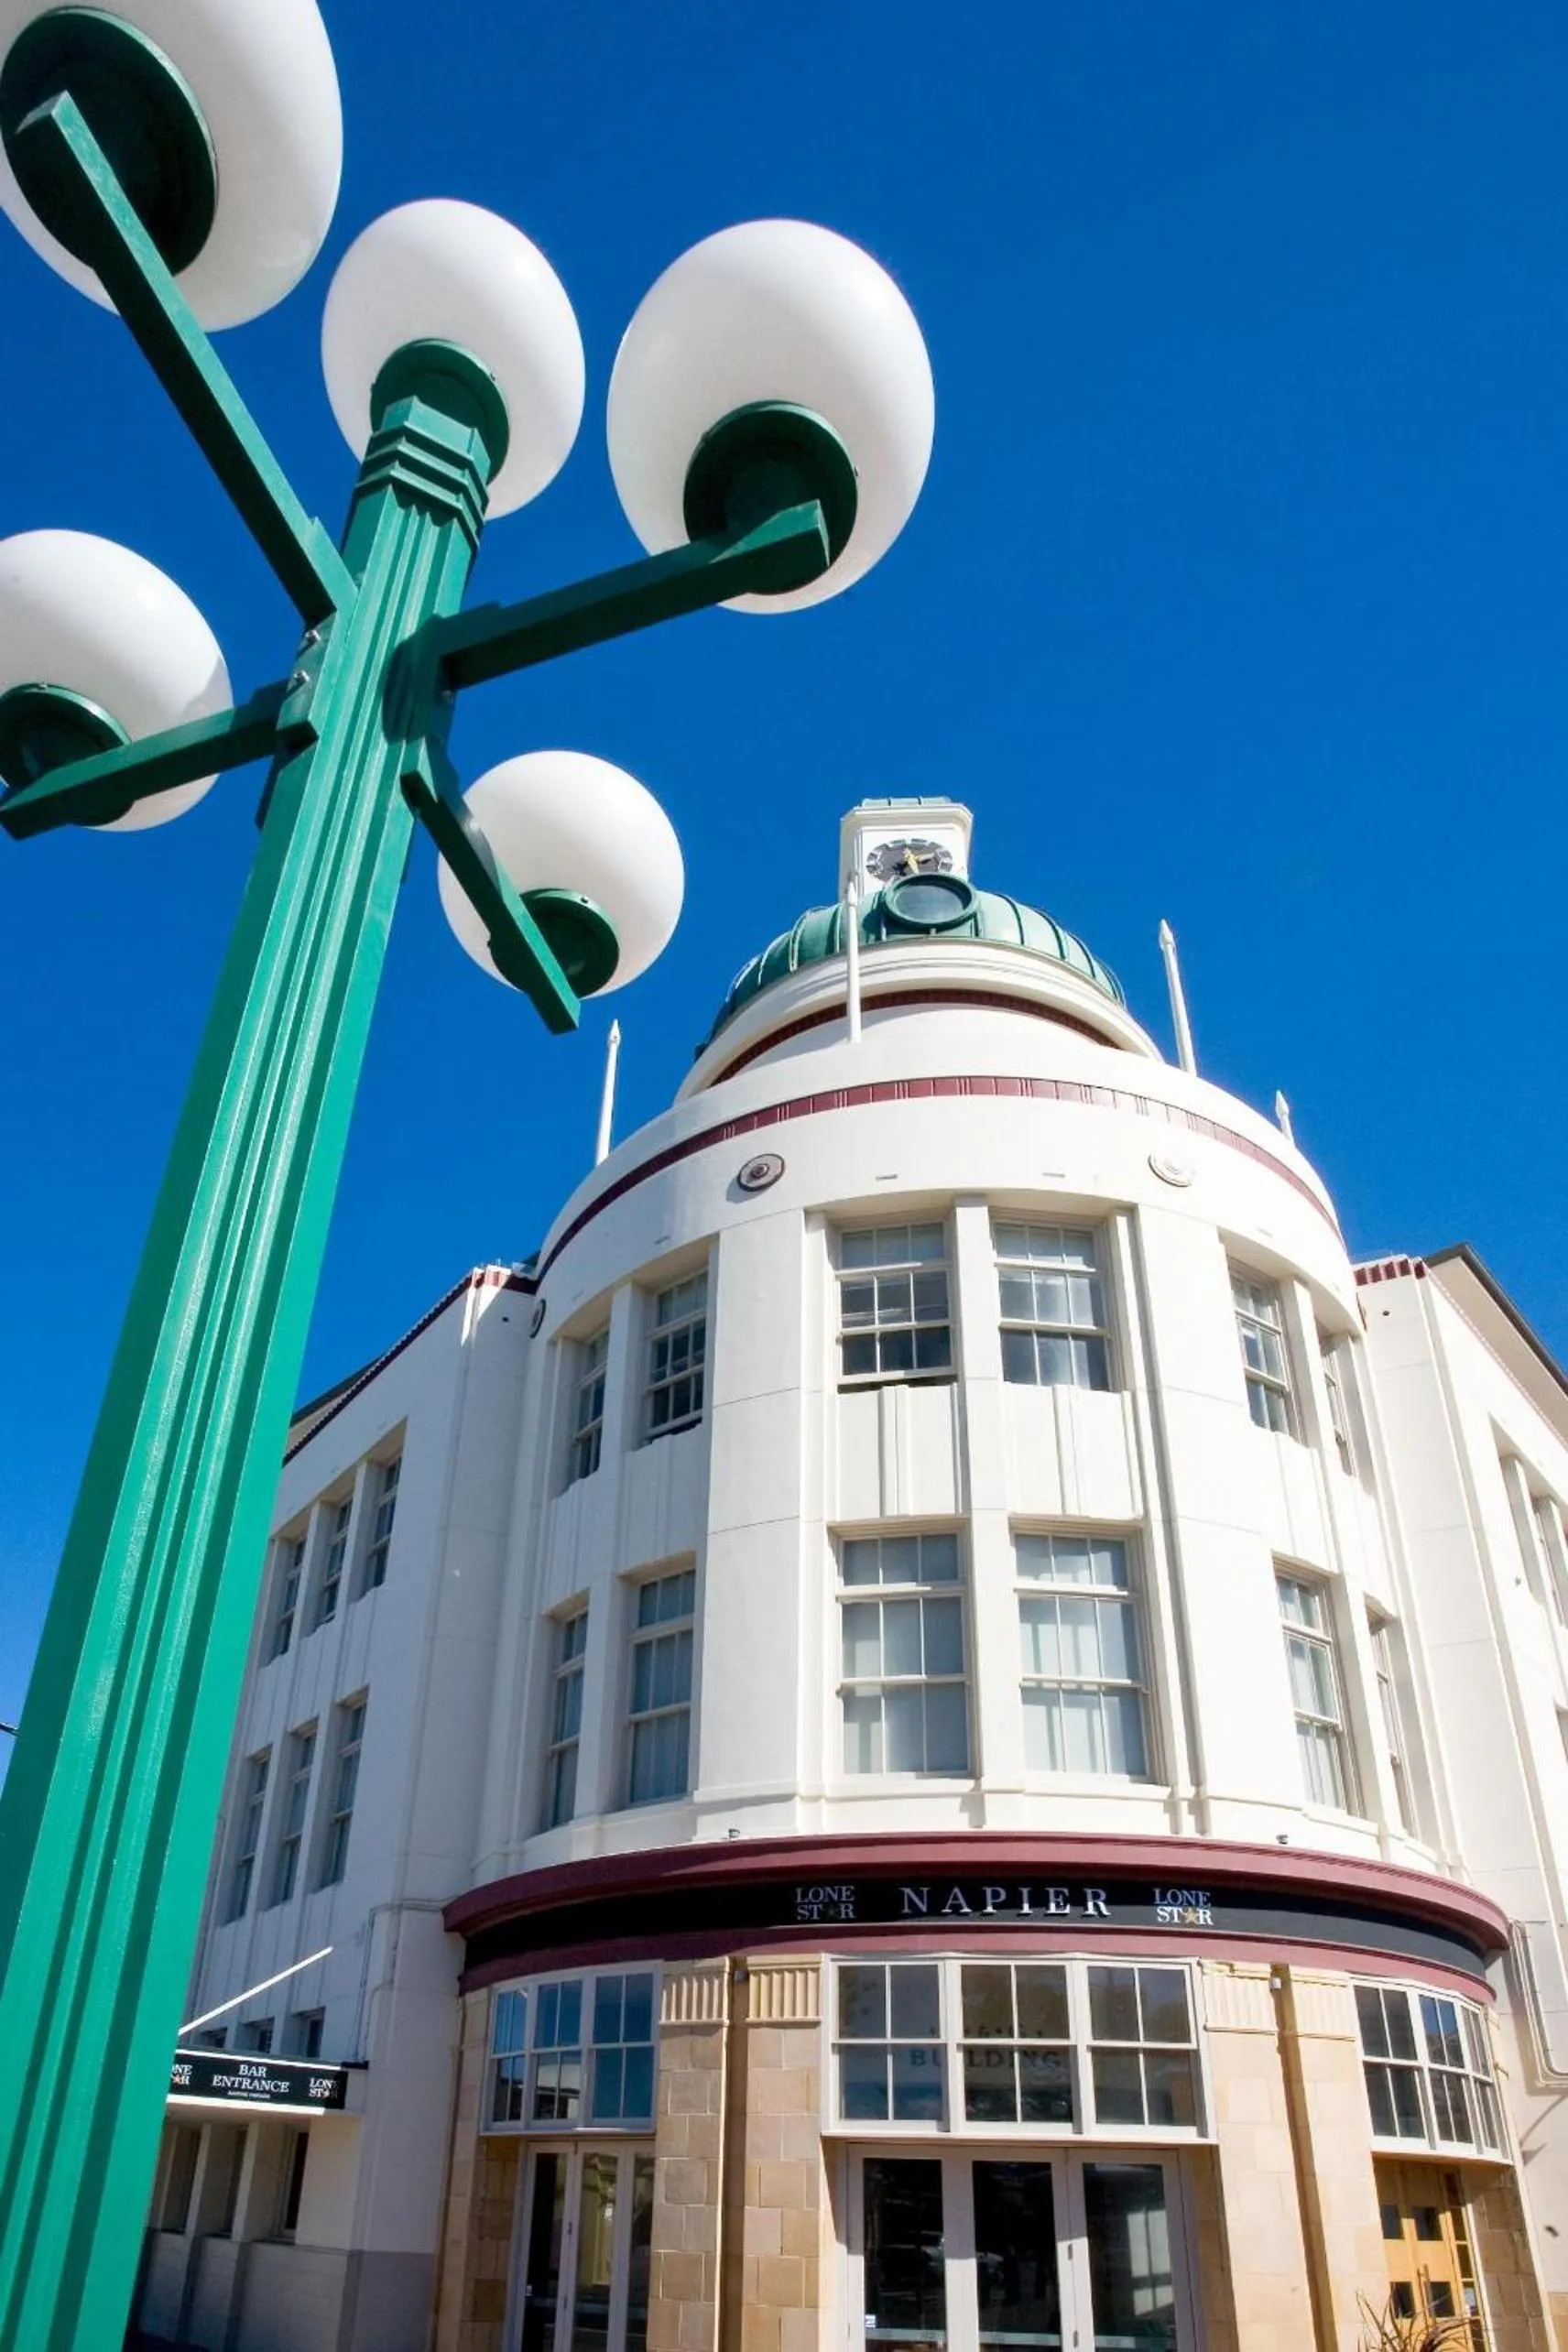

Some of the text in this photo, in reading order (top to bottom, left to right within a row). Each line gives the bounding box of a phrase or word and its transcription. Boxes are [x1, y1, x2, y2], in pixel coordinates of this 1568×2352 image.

[795, 1886, 855, 1902] LONE
[898, 1887, 1112, 1915] NAPIER
[1153, 1889, 1211, 1907] LONE
[239, 2064, 267, 2077] BAR
[212, 2074, 289, 2093] ENTRANCE
